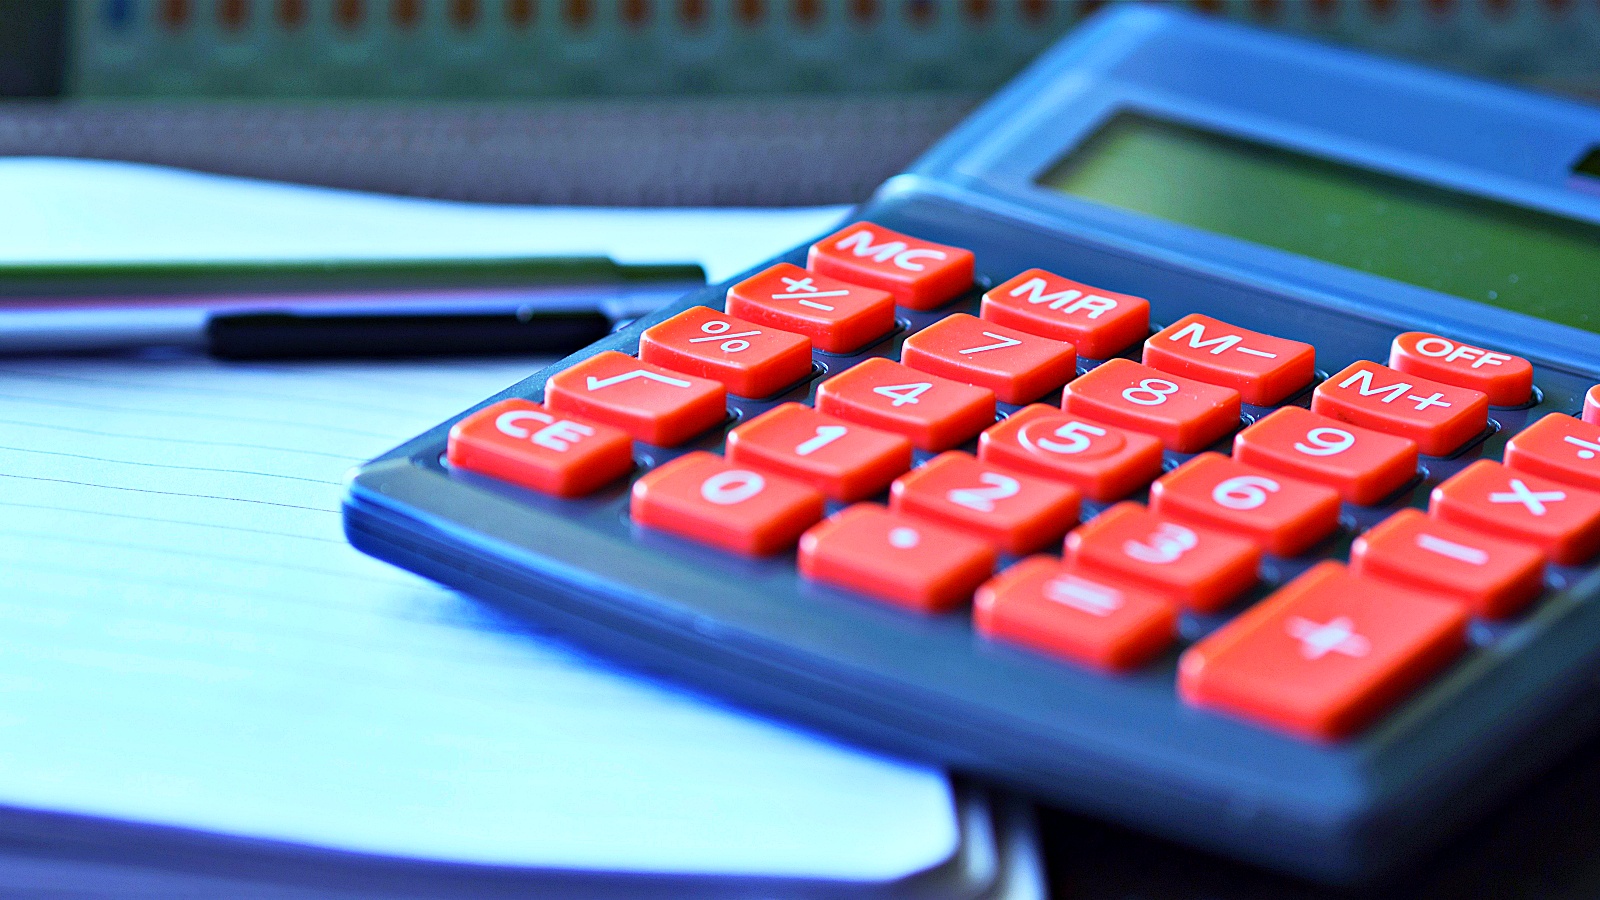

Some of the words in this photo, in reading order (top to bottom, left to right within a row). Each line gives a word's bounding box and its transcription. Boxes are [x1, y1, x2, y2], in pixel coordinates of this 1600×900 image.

[838, 232, 947, 271] MC
[1011, 279, 1117, 318] MR
[689, 320, 761, 352] %
[959, 331, 1022, 354] 7
[1416, 338, 1512, 369] OFF
[873, 382, 932, 406] 4
[1122, 378, 1179, 405] 8
[1338, 369, 1452, 411] M+
[496, 410, 593, 451] CE
[797, 426, 847, 455] 1
[1038, 421, 1106, 453] 5
[1295, 427, 1355, 456] 9
[702, 471, 763, 504] 0
[949, 473, 1019, 511] 2
[1213, 476, 1279, 509] 6
[1126, 523, 1197, 560] 3
